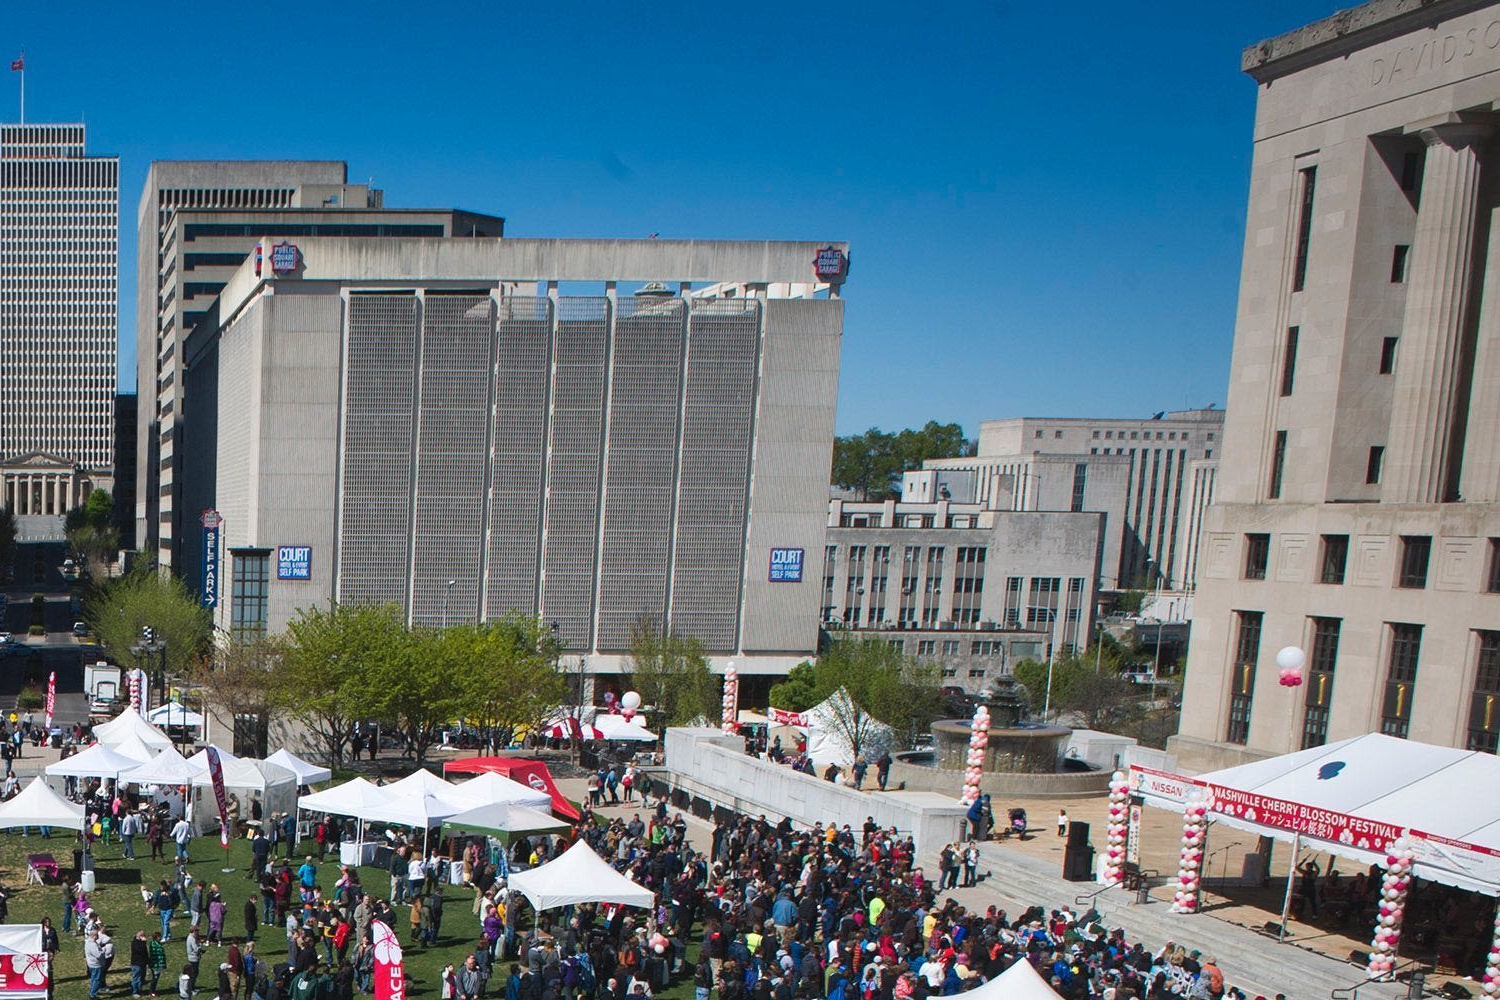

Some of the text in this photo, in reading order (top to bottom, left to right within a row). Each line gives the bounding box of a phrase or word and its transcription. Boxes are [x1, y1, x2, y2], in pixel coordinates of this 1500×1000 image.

[207, 532, 215, 562] SELF
[280, 547, 310, 562] COURT
[772, 550, 803, 564] COURT
[206, 564, 215, 594] PARK
[279, 568, 308, 577] SELF PARK
[771, 570, 801, 579] SELF PARK
[1151, 781, 1183, 797] NISSAN
[1214, 786, 1398, 840] NASHVILLE CHERRY BLOSSOM FESTIVAL
